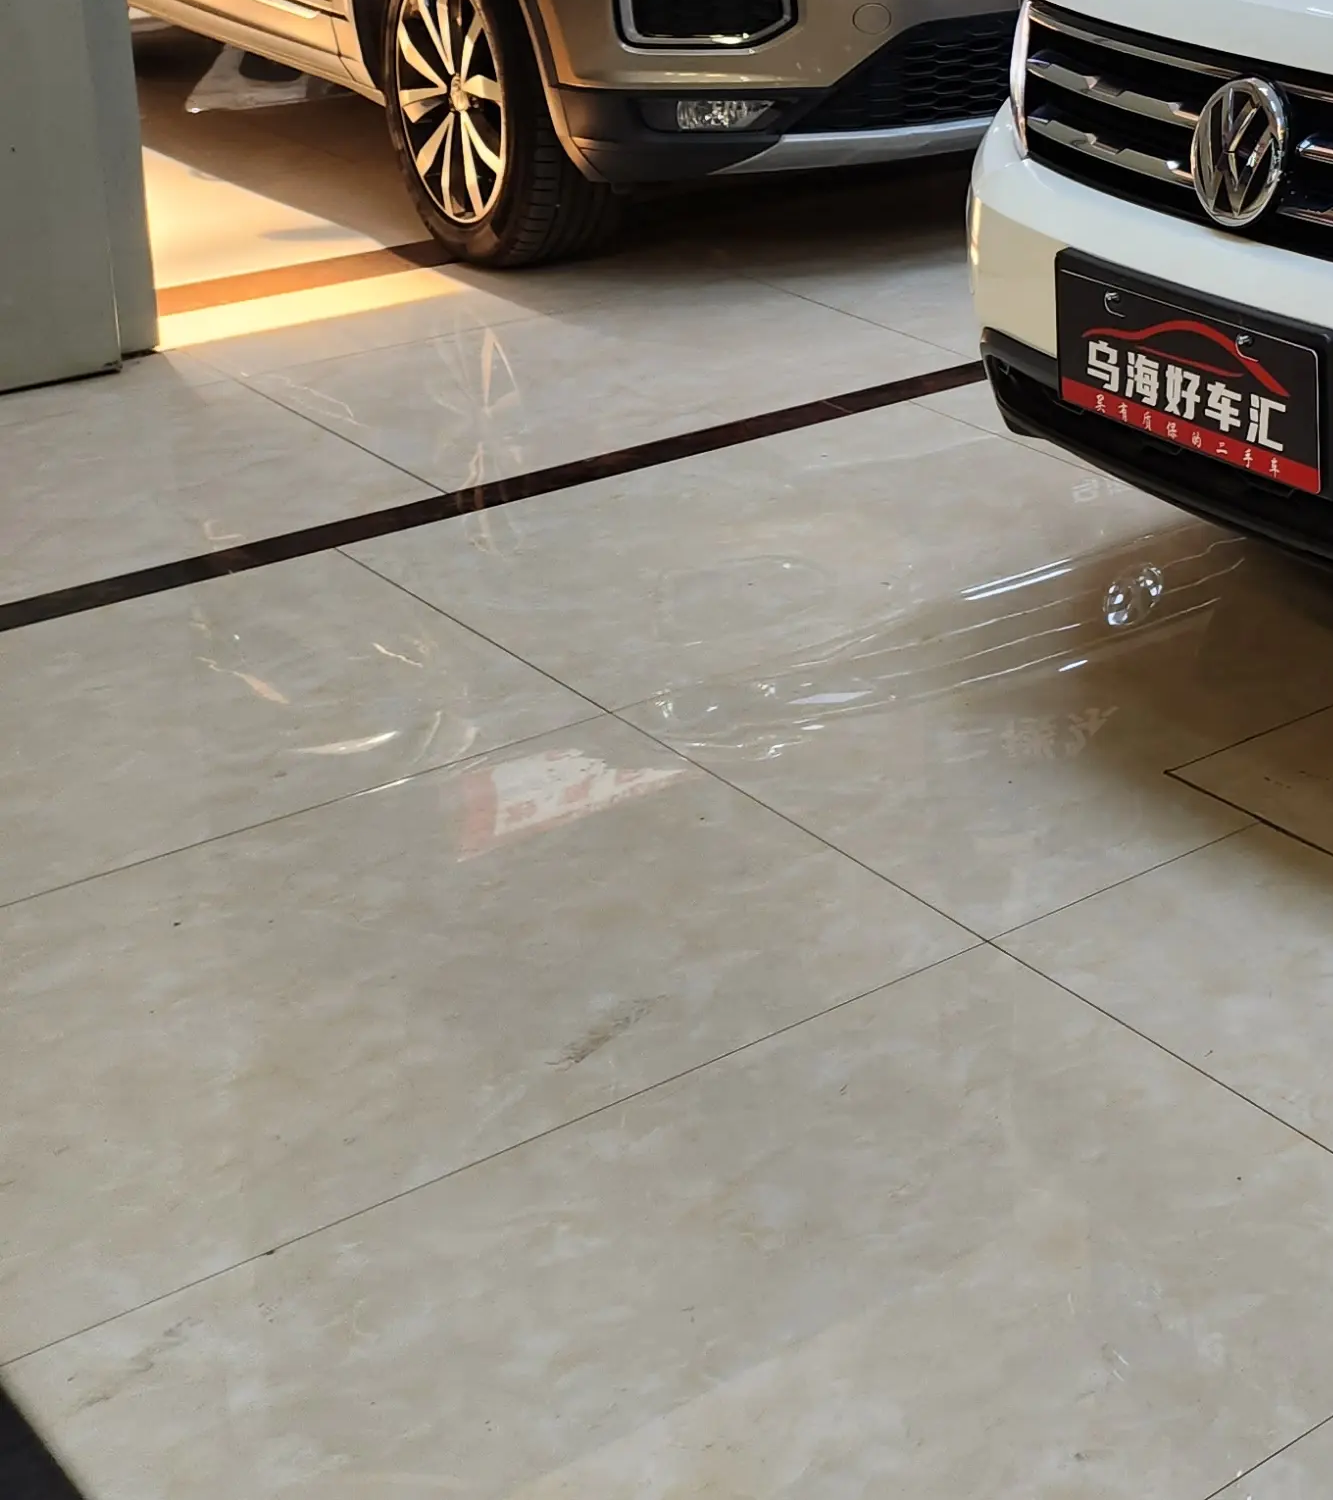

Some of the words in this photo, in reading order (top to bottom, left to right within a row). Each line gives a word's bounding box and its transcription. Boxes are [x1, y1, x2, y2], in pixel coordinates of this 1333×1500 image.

[1086, 339, 1287, 452] 乌海好车汇
